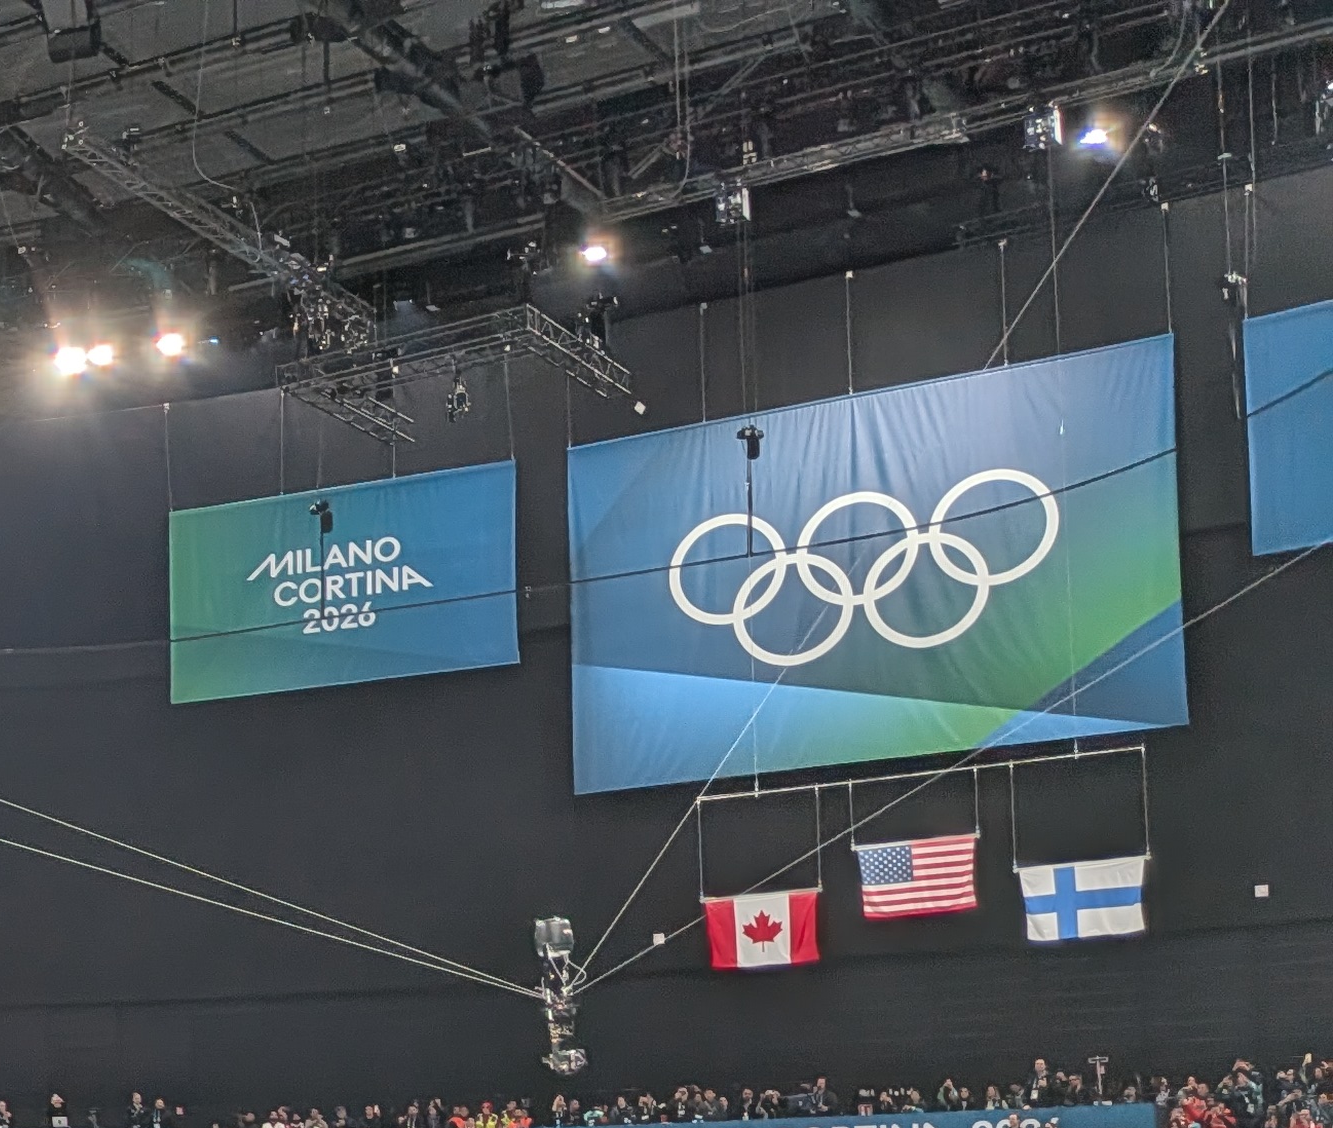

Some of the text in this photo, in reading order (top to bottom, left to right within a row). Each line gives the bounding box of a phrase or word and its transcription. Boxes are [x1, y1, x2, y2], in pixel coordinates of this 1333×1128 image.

[246, 536, 401, 581] MILANO
[274, 565, 434, 607] CORTINA
[302, 601, 377, 634] 2026
